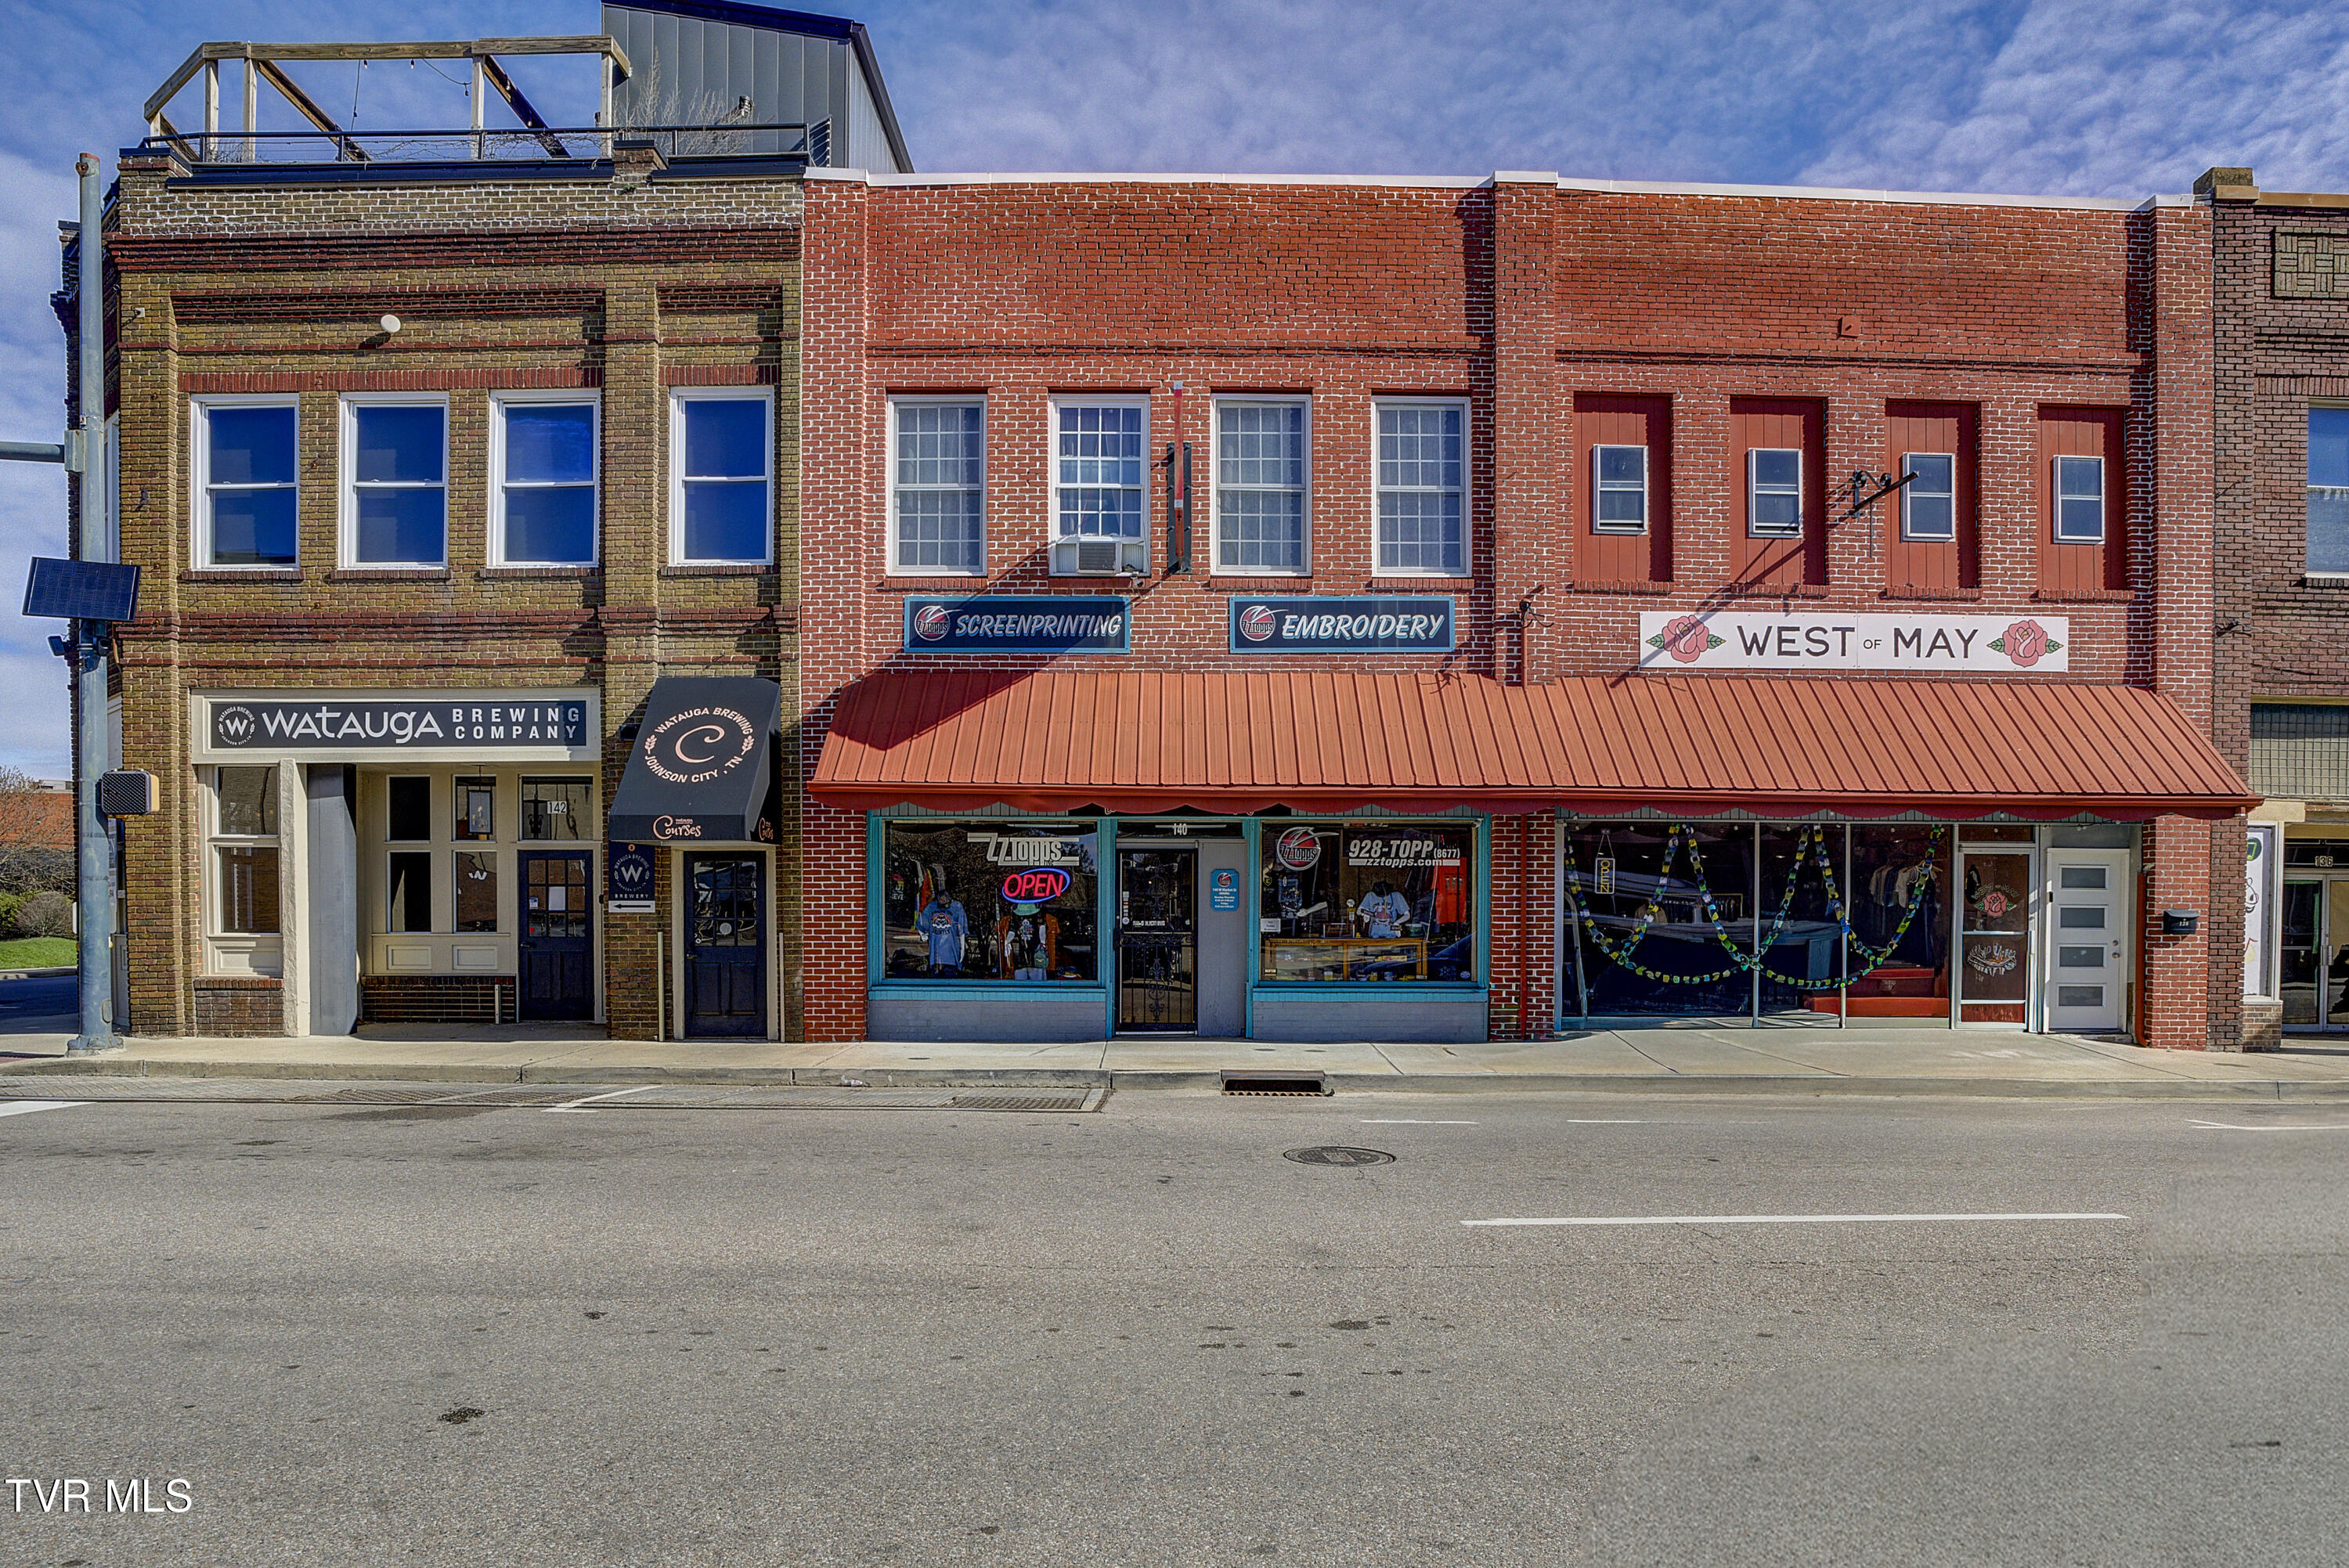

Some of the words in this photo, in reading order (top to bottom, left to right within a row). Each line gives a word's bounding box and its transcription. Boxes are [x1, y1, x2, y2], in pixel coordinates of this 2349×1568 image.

[955, 615, 1122, 637] SCREENPRINTING
[1282, 615, 1445, 640] EMBROIDERY
[1737, 625, 1856, 657] WEST
[1863, 638, 1882, 650] OF
[1893, 627, 1979, 658] MAY
[452, 707, 580, 723] BREWING
[655, 708, 710, 734] WATAUGA
[713, 707, 753, 735] BREWING
[455, 725, 576, 740] COMPANY
[644, 755, 688, 783] JOHNSON
[724, 755, 743, 769] TN
[548, 802, 567, 814] 142
[653, 815, 702, 840] Courses
[1172, 823, 1189, 836] 140
[1348, 839, 1434, 859] 928-TOPP
[1433, 848, 1461, 860] (8677)
[1366, 857, 1443, 868] zztopps.com
[2315, 856, 2333, 867] 136
[621, 864, 643, 883] W
[1600, 860, 1611, 894] OPEN
[1003, 874, 1063, 897] OPEN
